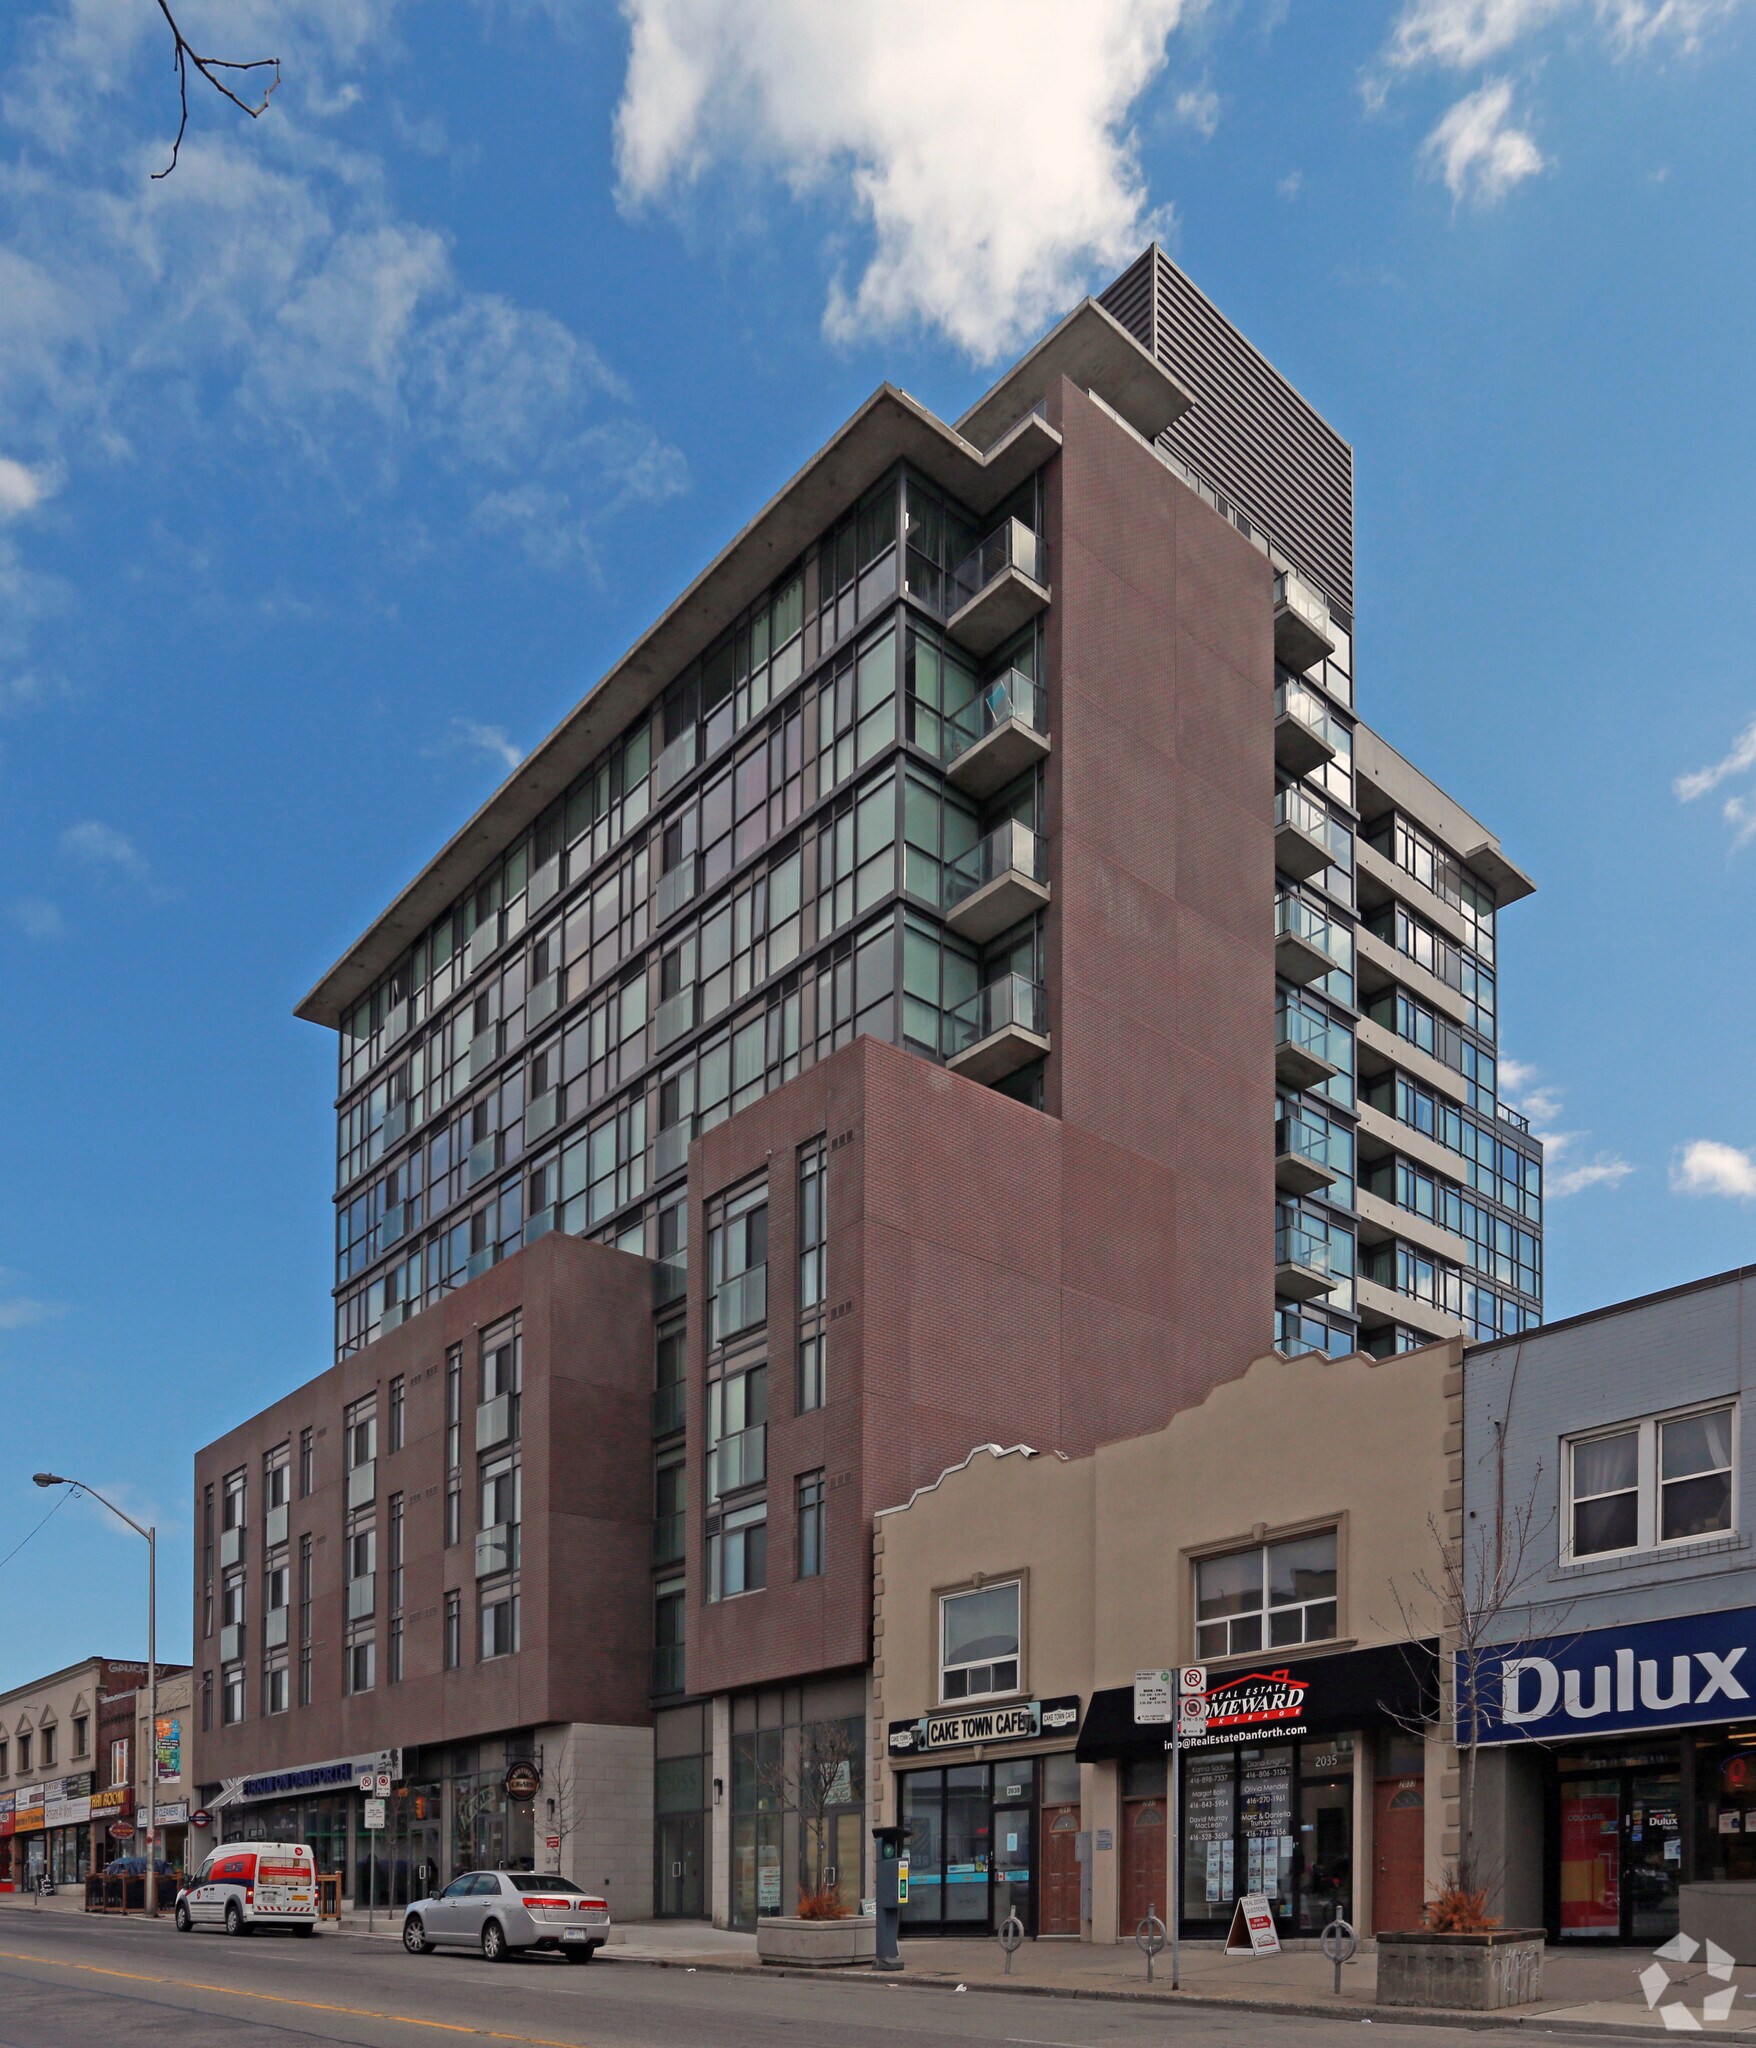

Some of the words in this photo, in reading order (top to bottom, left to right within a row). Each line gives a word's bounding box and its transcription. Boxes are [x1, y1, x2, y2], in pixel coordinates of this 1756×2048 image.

[1211, 1691, 1238, 1701] REAL
[1245, 1683, 1287, 1696] ESTATE
[1501, 1646, 1751, 1725] Dulux
[931, 1721, 959, 1744] CAKE
[962, 1715, 993, 1739] TOWN
[1164, 1726, 1307, 1750] ino@RealEstateDanforth.com
[1315, 1755, 1338, 1767] 2035
[275, 1774, 290, 1791] ON
[291, 1763, 352, 1789] DANFORTH
[103, 1790, 125, 1805] ROOM
[1649, 1816, 1678, 1826] Dulux
